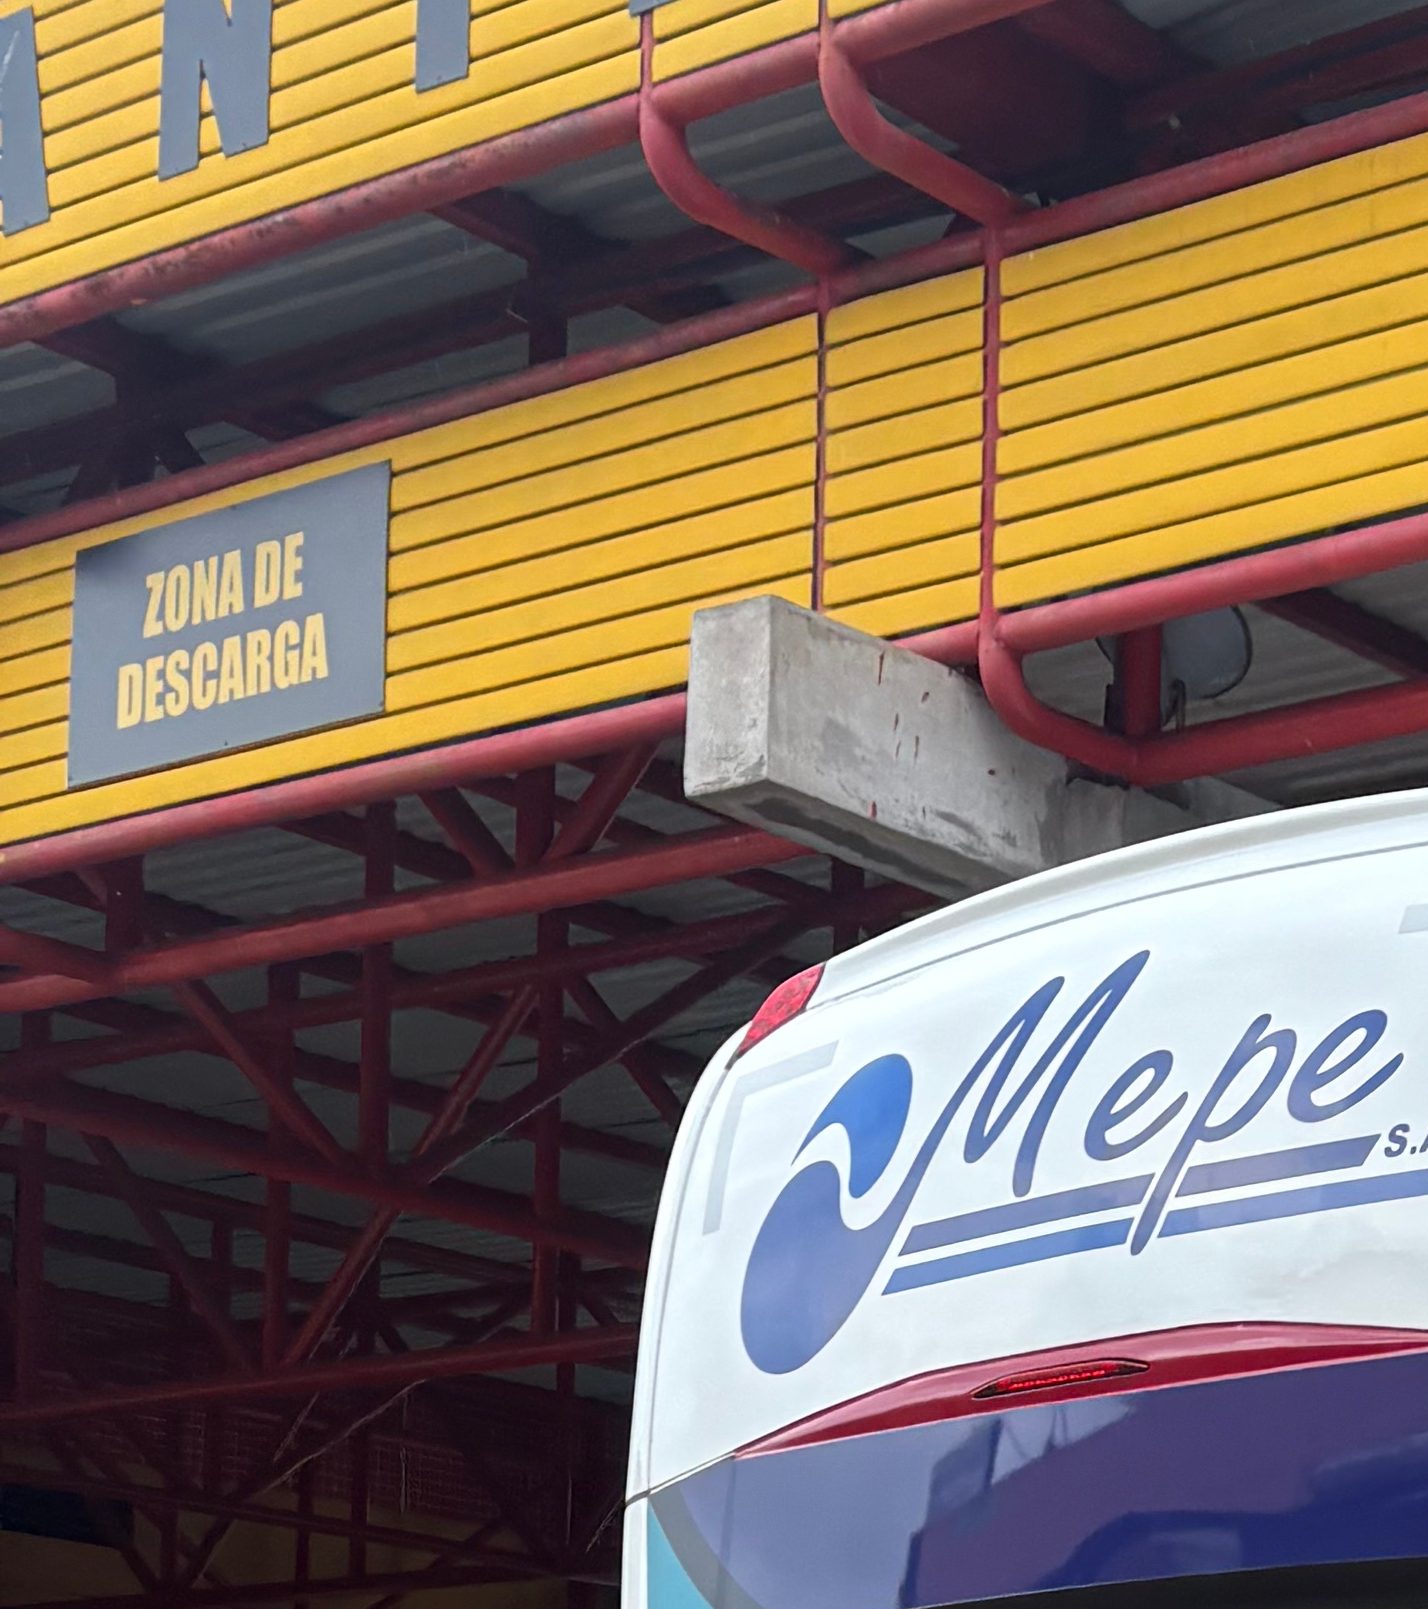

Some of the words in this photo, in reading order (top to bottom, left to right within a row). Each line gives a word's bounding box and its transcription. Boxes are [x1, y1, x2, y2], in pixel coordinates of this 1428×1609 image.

[143, 550, 244, 639] ZONA
[253, 532, 305, 609] DE
[116, 613, 329, 730] DESCARGA
[888, 949, 1404, 1255] Mepe
